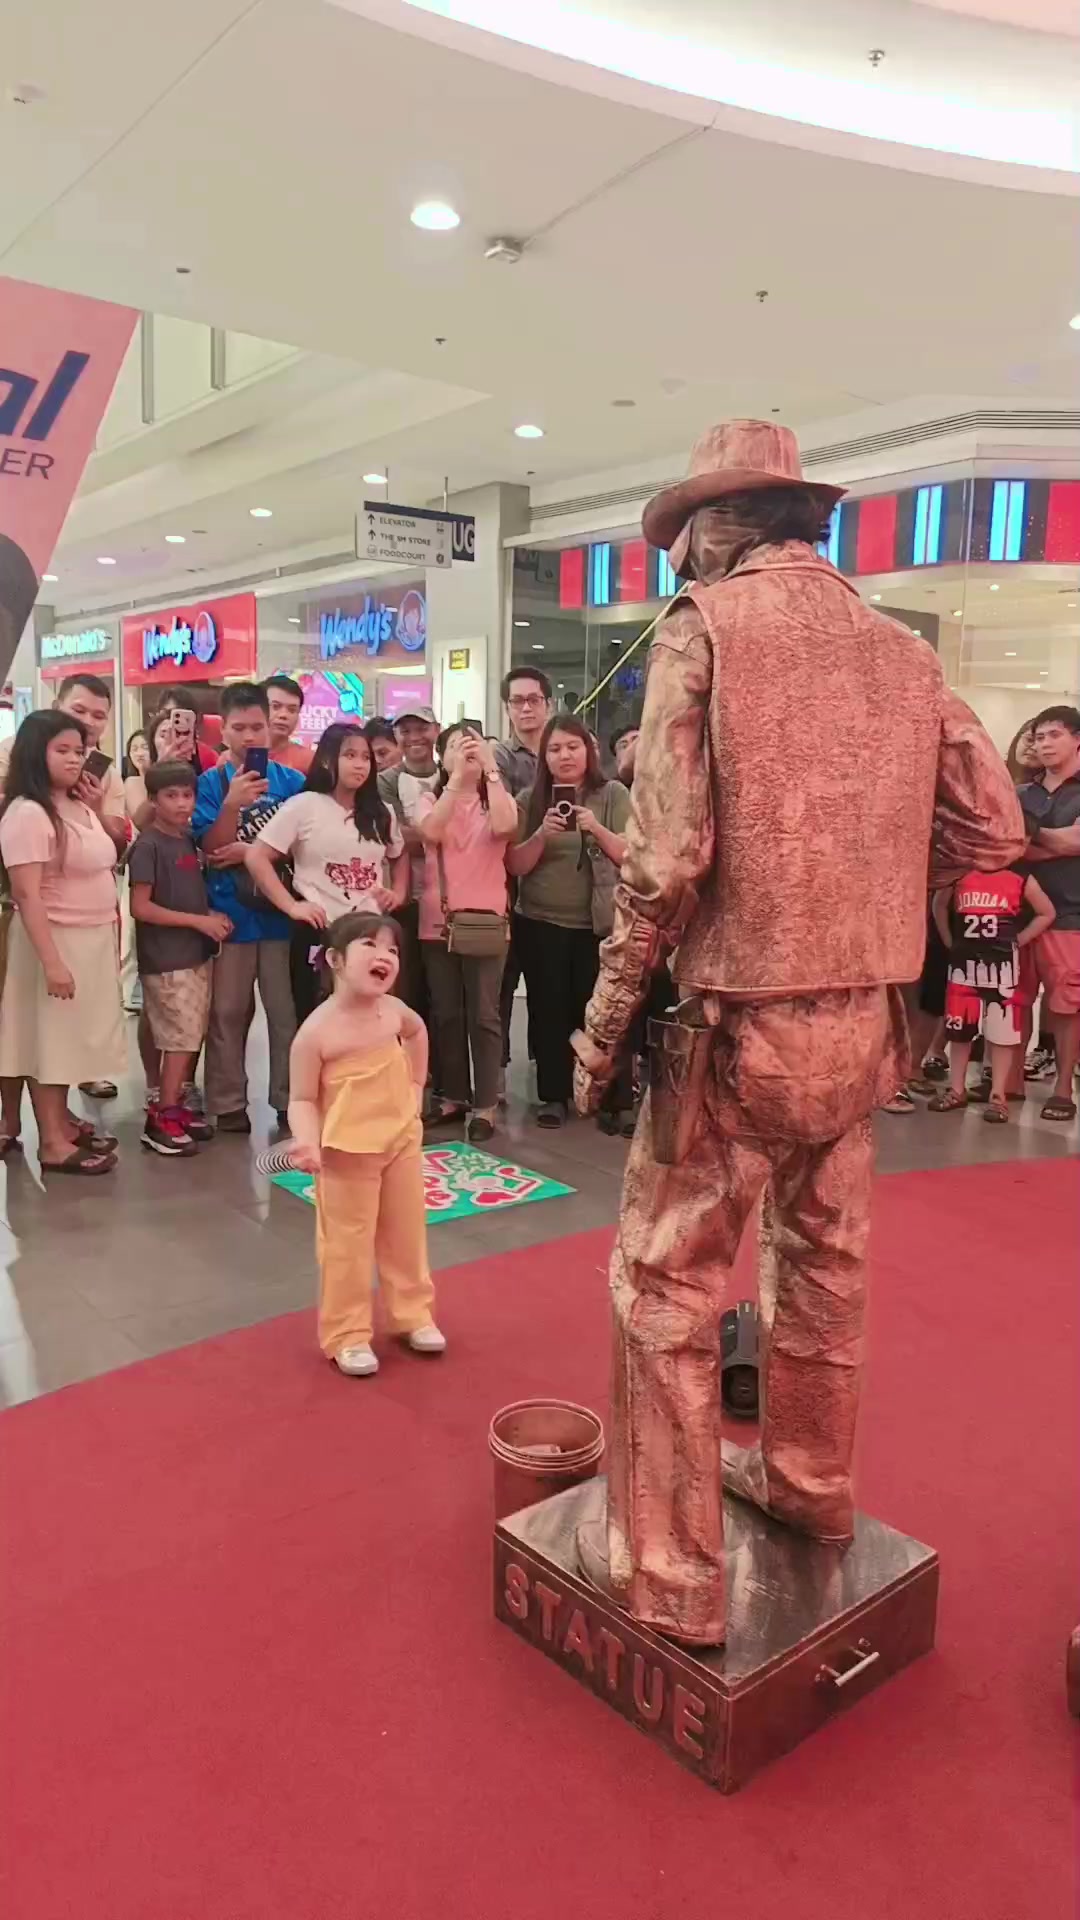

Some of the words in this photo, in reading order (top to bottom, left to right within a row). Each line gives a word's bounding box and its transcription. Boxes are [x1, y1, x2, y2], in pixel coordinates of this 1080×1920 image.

[0, 448, 54, 480] ER
[379, 517, 416, 528] ELEVATOR
[380, 533, 394, 542] THE
[396, 535, 406, 543] SM
[408, 537, 431, 546] STORE
[453, 521, 475, 554] UG
[379, 548, 426, 560] FOODCOURT
[320, 595, 393, 661] Wendy's
[142, 615, 191, 671] Wendy's
[963, 914, 998, 939] 23
[945, 1013, 963, 1031] 23
[504, 1563, 707, 1760] STATUE
